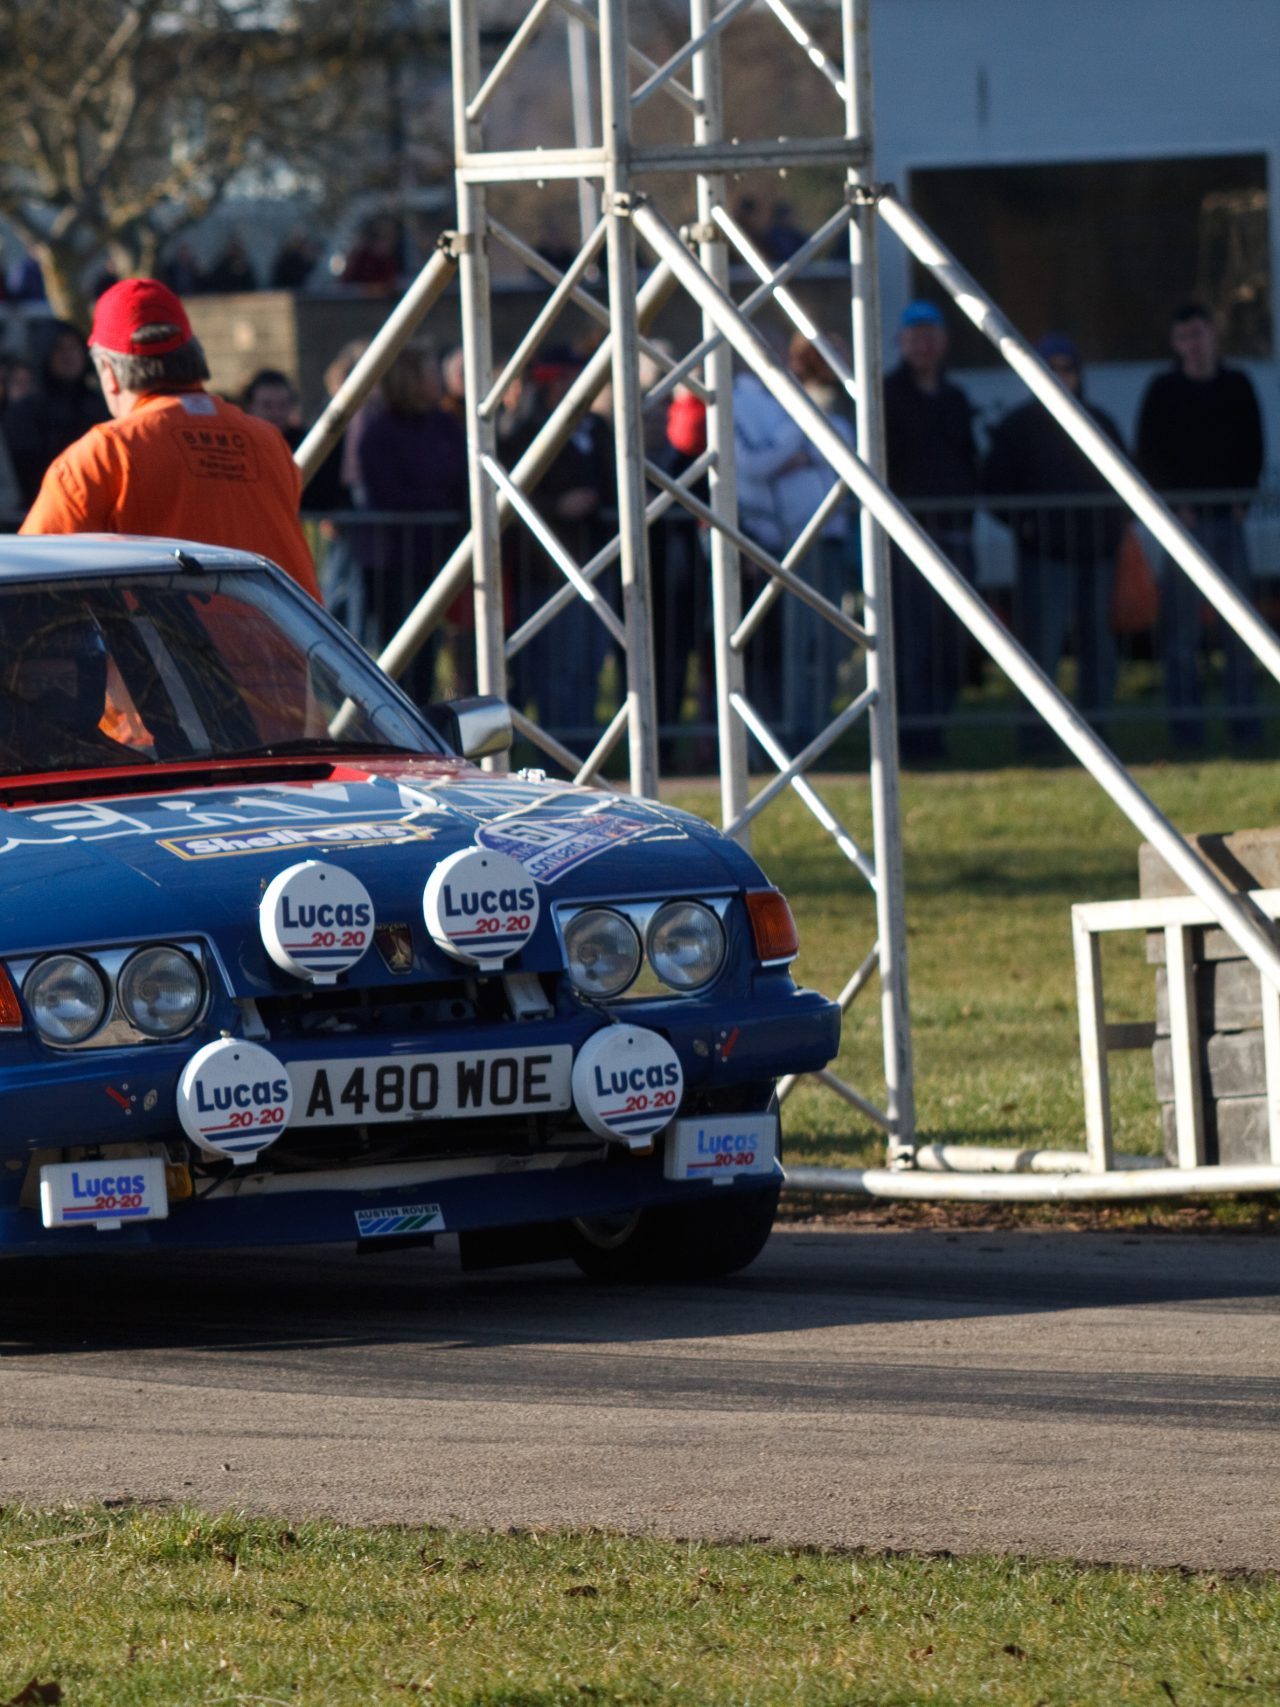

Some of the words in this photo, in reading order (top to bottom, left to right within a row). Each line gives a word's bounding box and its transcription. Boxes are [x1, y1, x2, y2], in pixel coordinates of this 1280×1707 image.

[185, 829, 308, 855] Shell
[281, 896, 371, 929] Lucas
[443, 885, 535, 917] Lucas
[474, 915, 531, 934] 20-20
[311, 931, 366, 948] 20-20
[306, 1062, 439, 1118] A480
[456, 1054, 553, 1109] WOE
[594, 1062, 680, 1097] Lucas
[195, 1079, 289, 1113] Lucas
[626, 1090, 676, 1112] 20-20
[228, 1107, 284, 1128] 20-20
[696, 1130, 758, 1155] Lucas
[714, 1152, 755, 1166] 20-20
[71, 1172, 146, 1199] Lucas
[94, 1194, 142, 1209] 20-20
[357, 1206, 399, 1219] AUSTIN
[402, 1203, 440, 1216] ROVER
